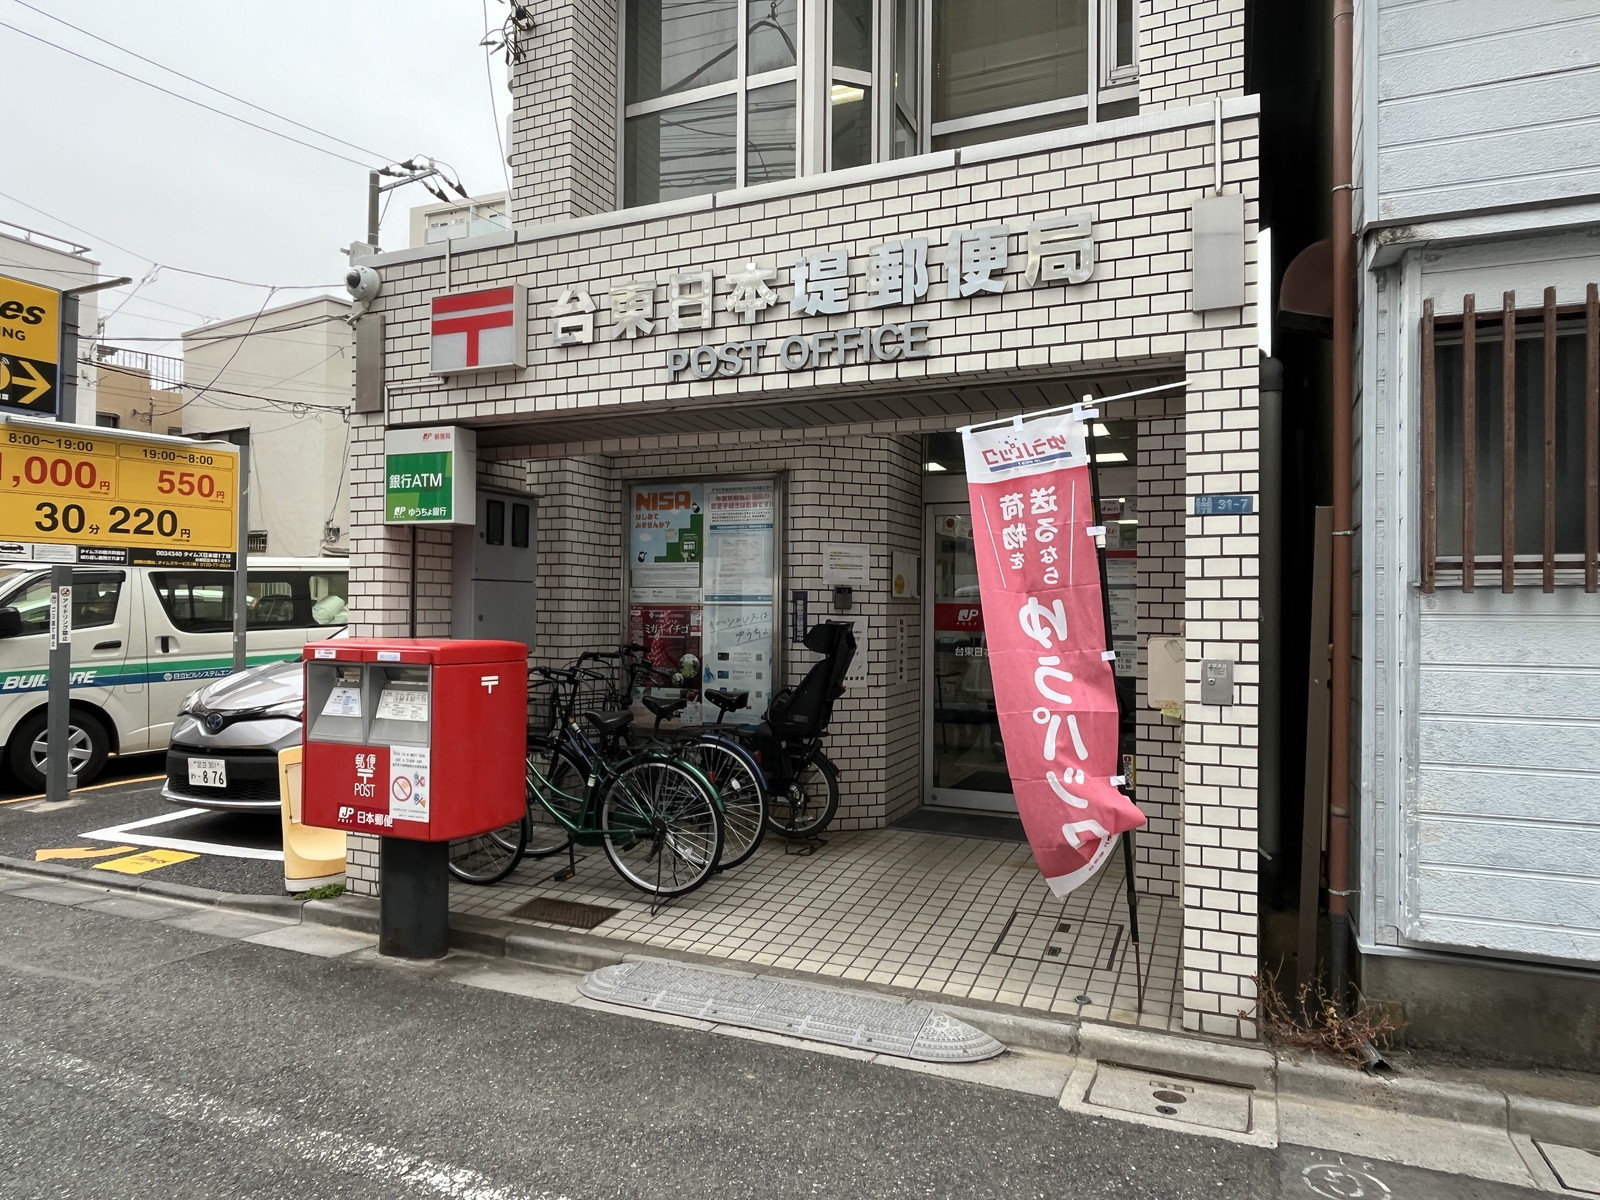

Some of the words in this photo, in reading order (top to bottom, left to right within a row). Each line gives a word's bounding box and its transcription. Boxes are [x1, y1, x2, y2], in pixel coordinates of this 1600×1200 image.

[550, 212, 1095, 348] 台東日本堤郵便局
[667, 340, 767, 383] POST
[780, 321, 930, 371] OFFICE
[389, 472, 443, 489] 銀行ATM
[635, 490, 691, 511] NISA
[408, 506, 447, 517] ゆうちょ銀行
[355, 753, 376, 770] 郵便
[354, 783, 376, 798] POST
[357, 811, 394, 828] 日本郵便
